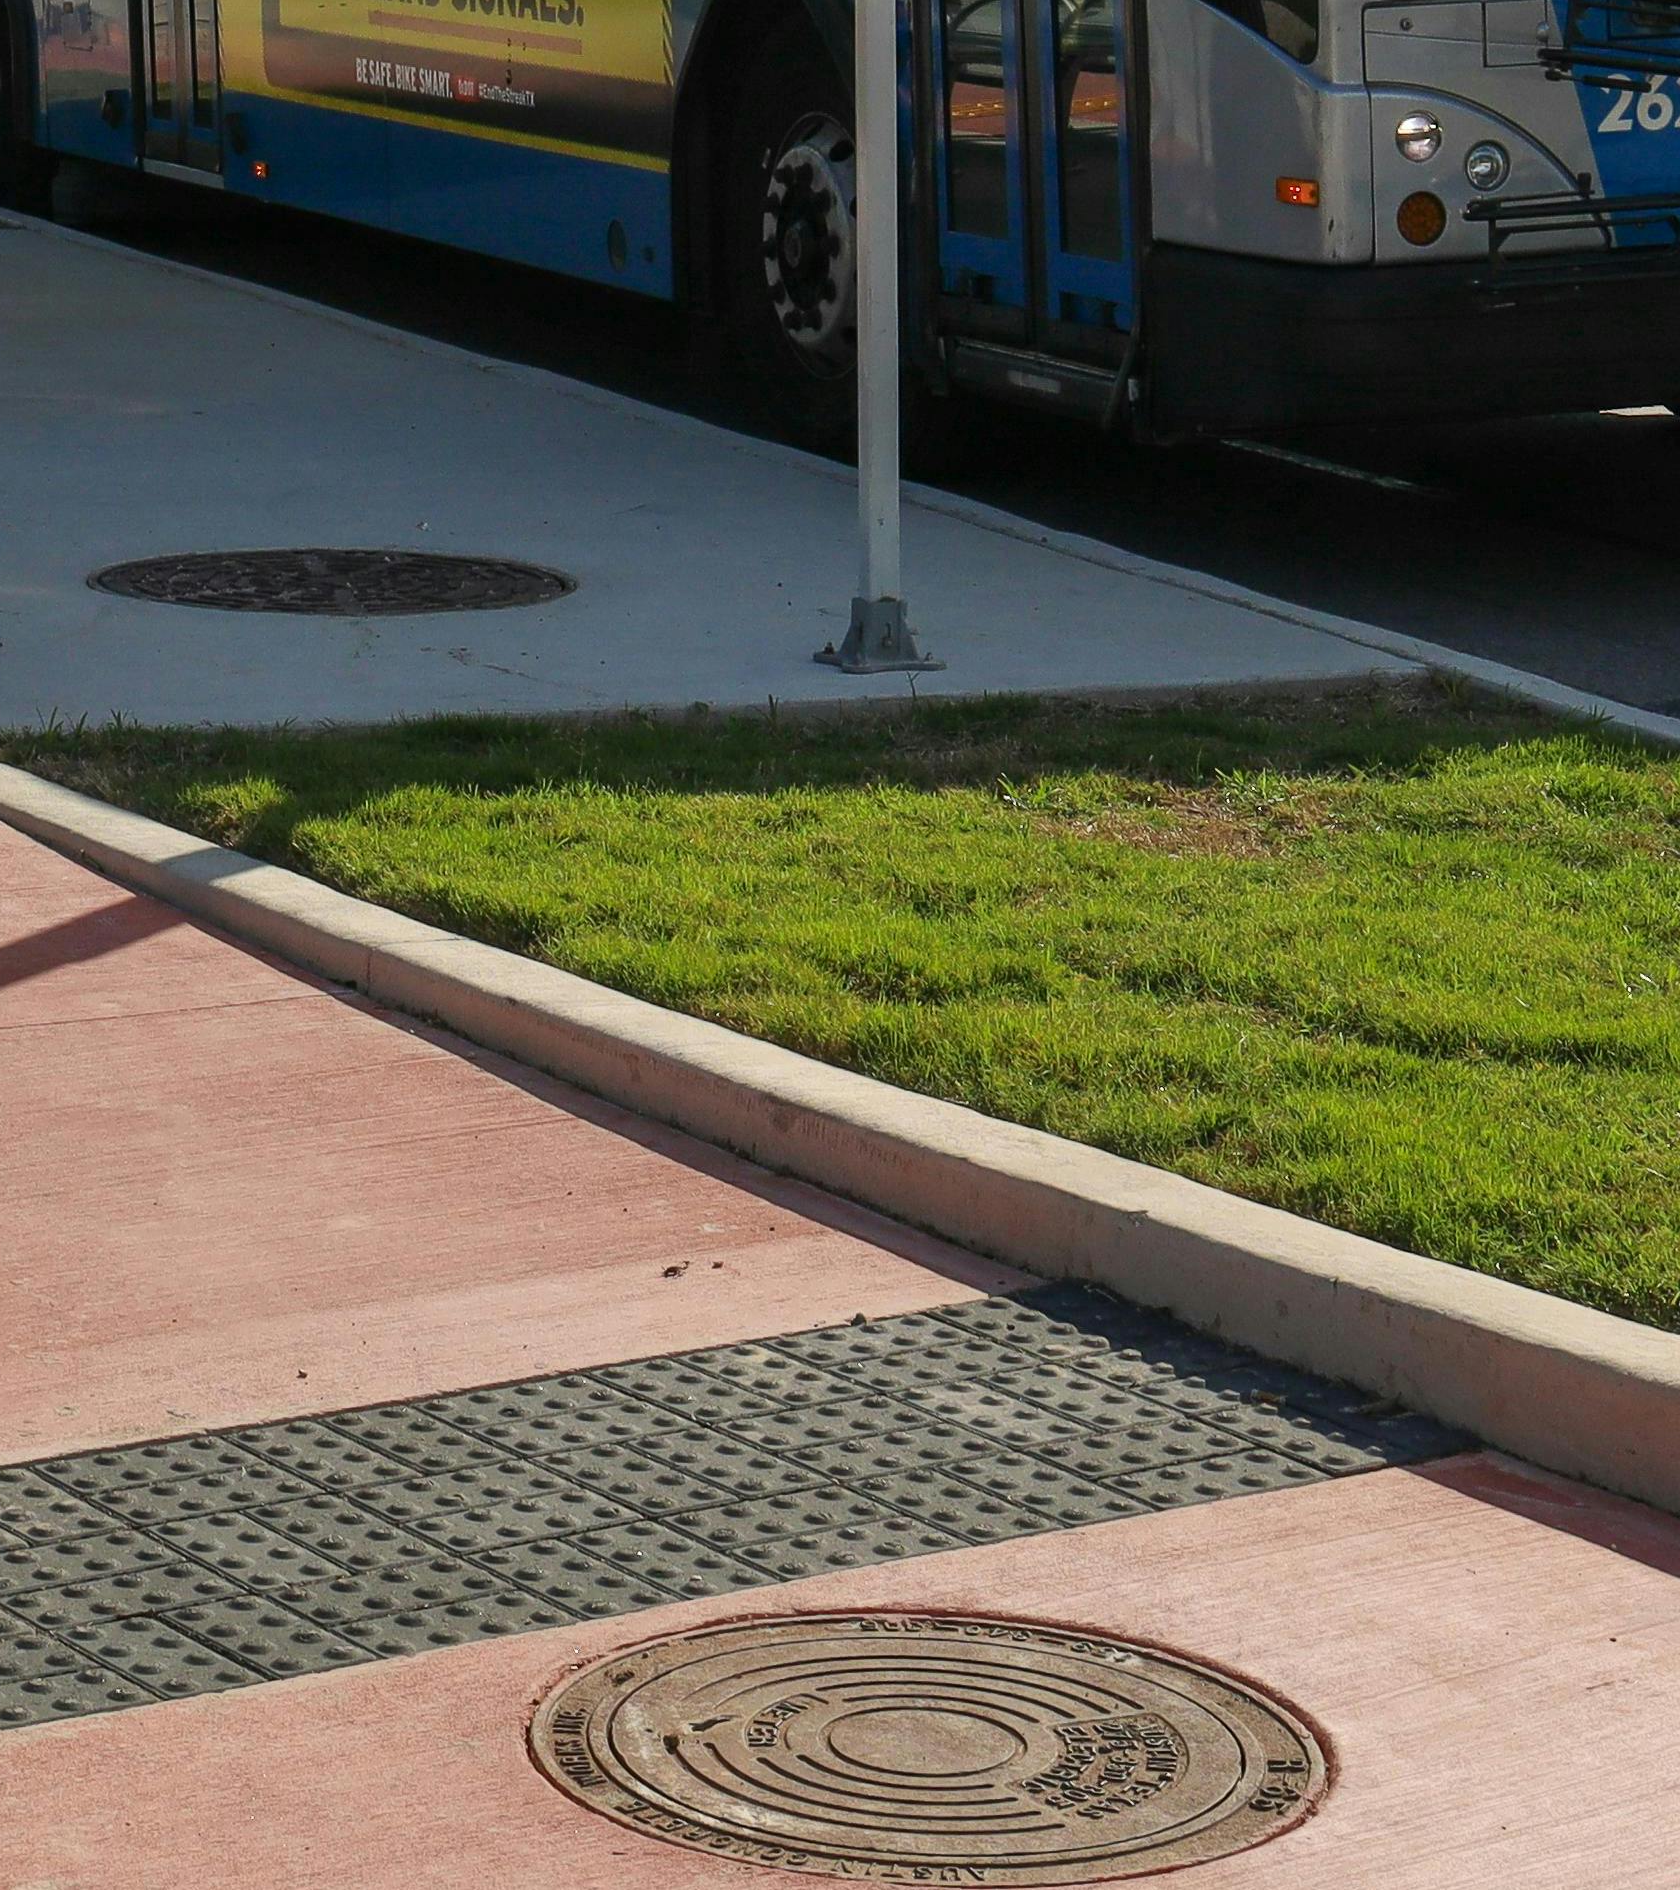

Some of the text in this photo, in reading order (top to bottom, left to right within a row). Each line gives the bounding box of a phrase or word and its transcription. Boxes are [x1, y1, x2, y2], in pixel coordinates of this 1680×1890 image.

[356, 57, 368, 83] BE
[369, 60, 395, 88] SAFE.
[395, 64, 417, 92] BIKE
[419, 68, 453, 99] SMART.
[479, 83, 536, 107] #EndTheStreakTX
[748, 1700, 809, 1748] METER
